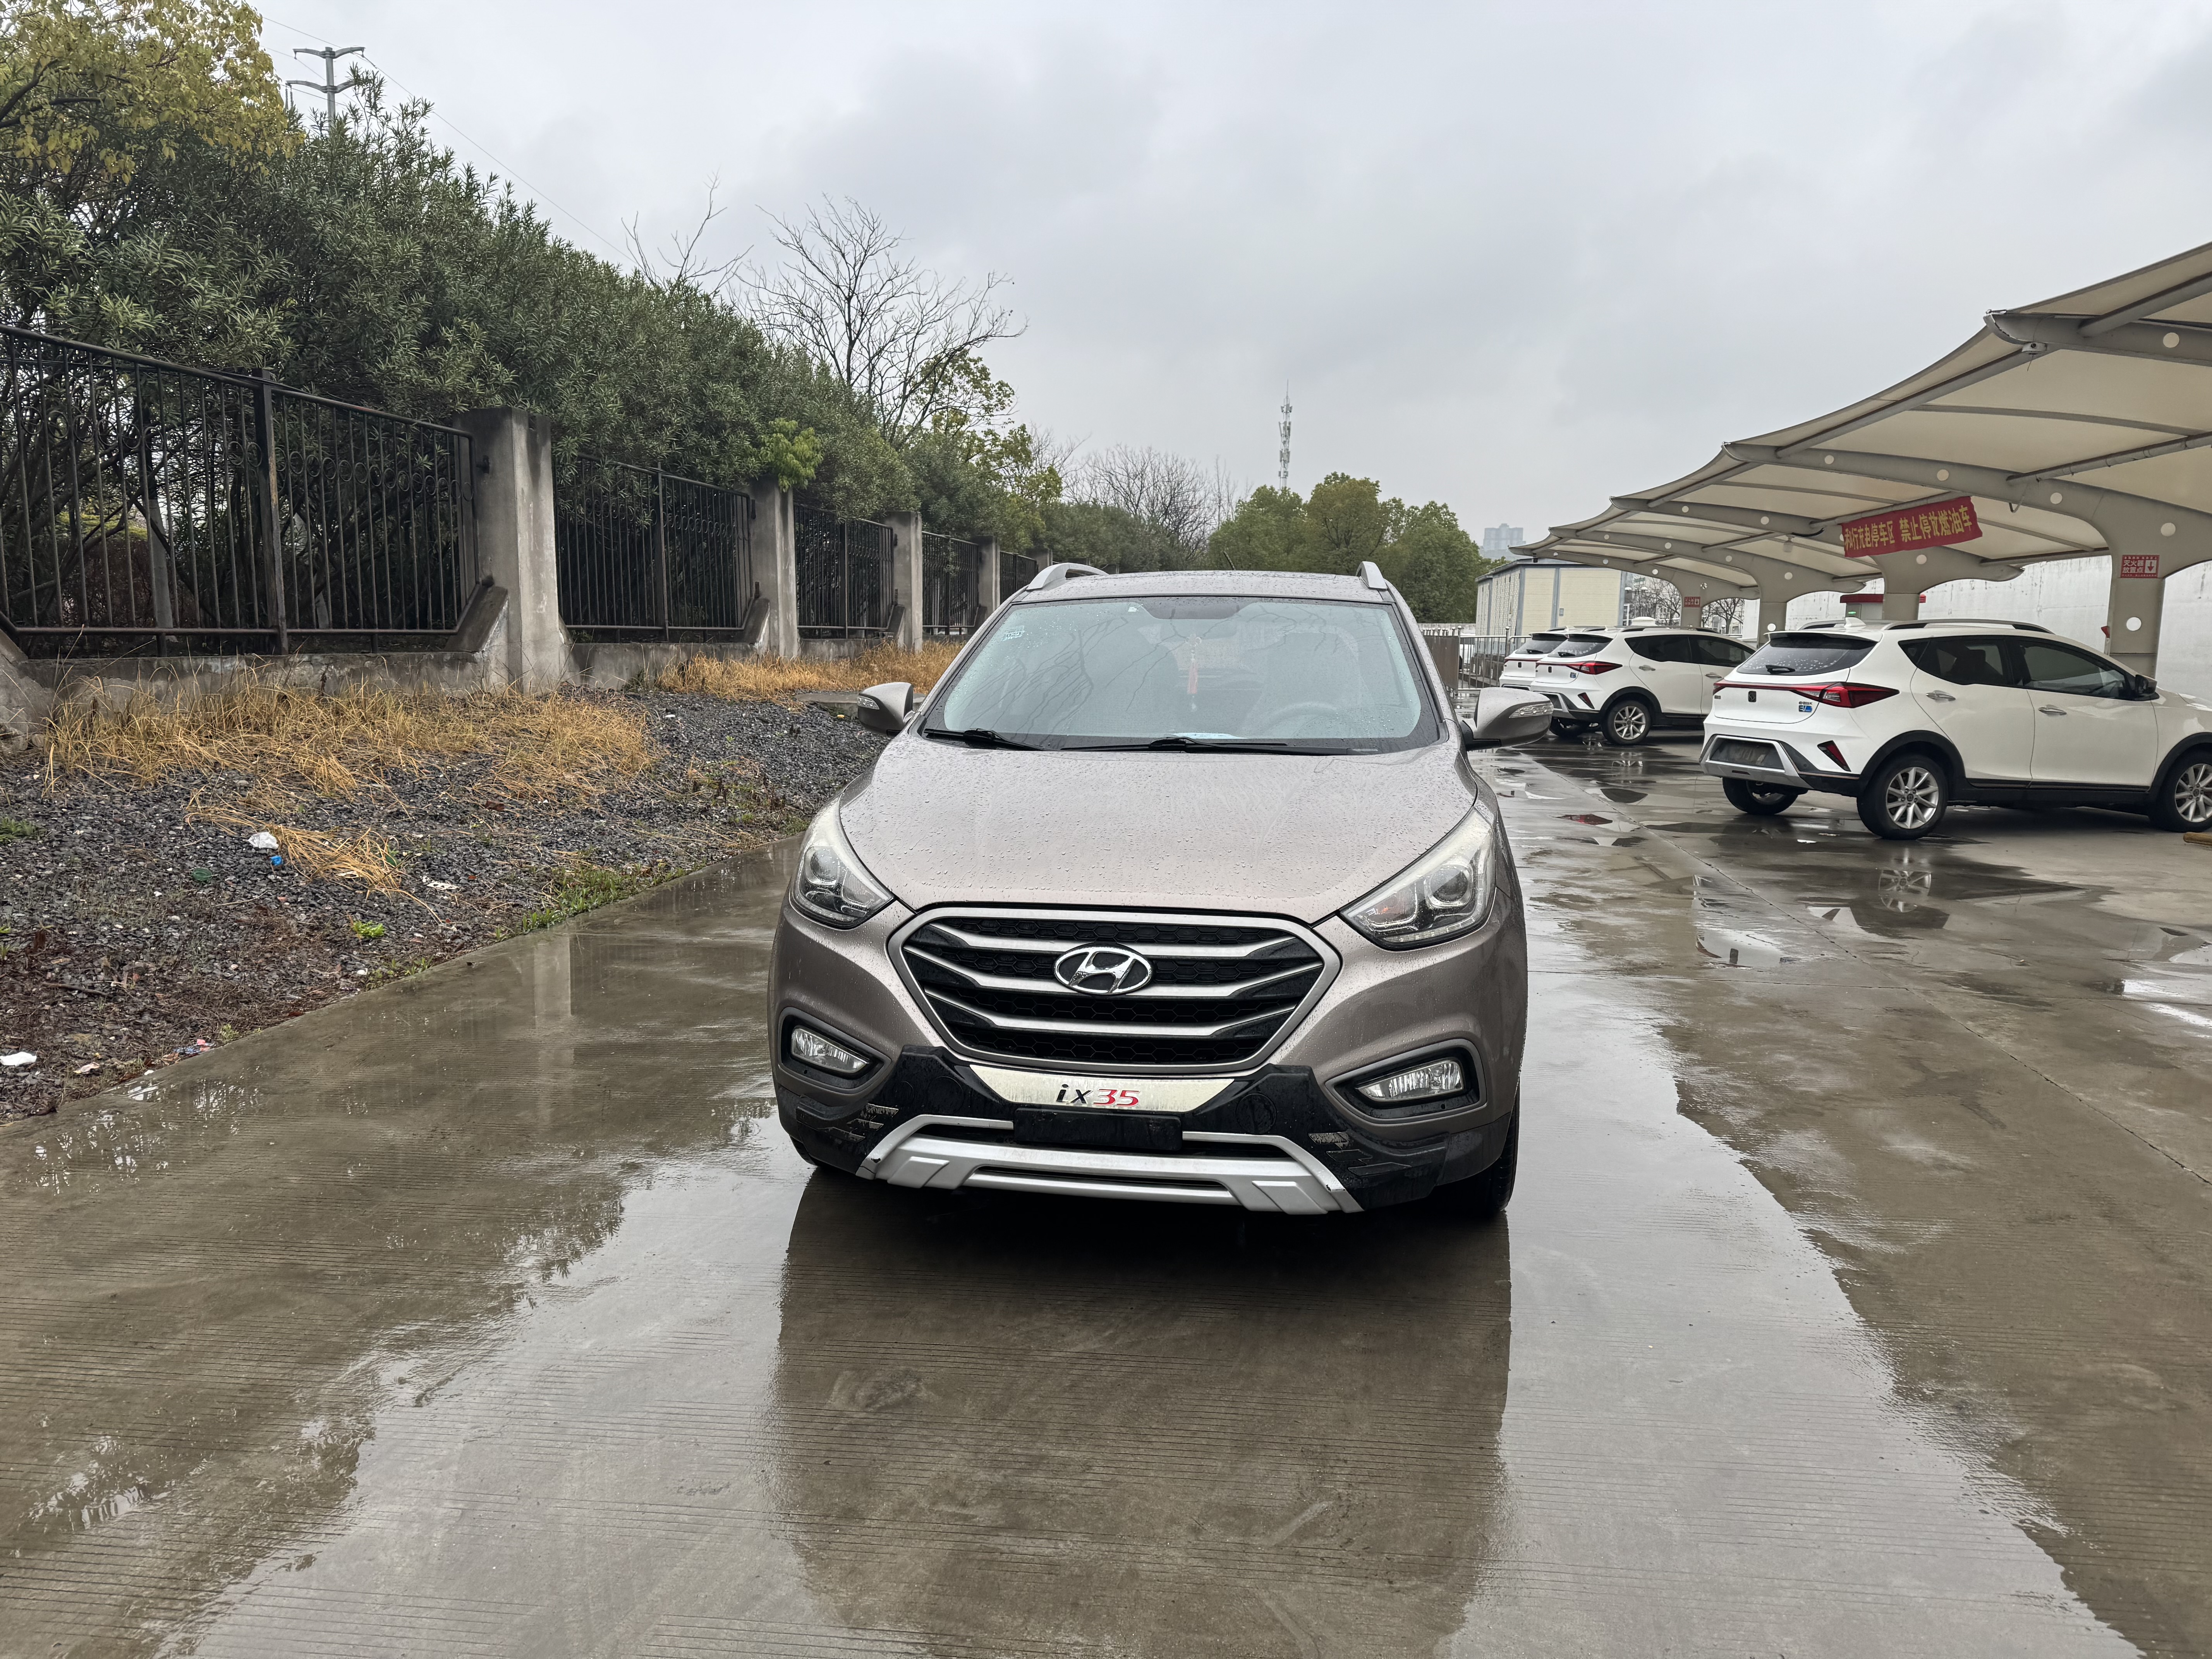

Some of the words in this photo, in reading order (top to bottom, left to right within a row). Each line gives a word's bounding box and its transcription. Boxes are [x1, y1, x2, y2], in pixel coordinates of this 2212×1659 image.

[1899, 505, 1972, 542] 禁止停放燃油车
[1056, 1084, 1140, 1107] ix35
